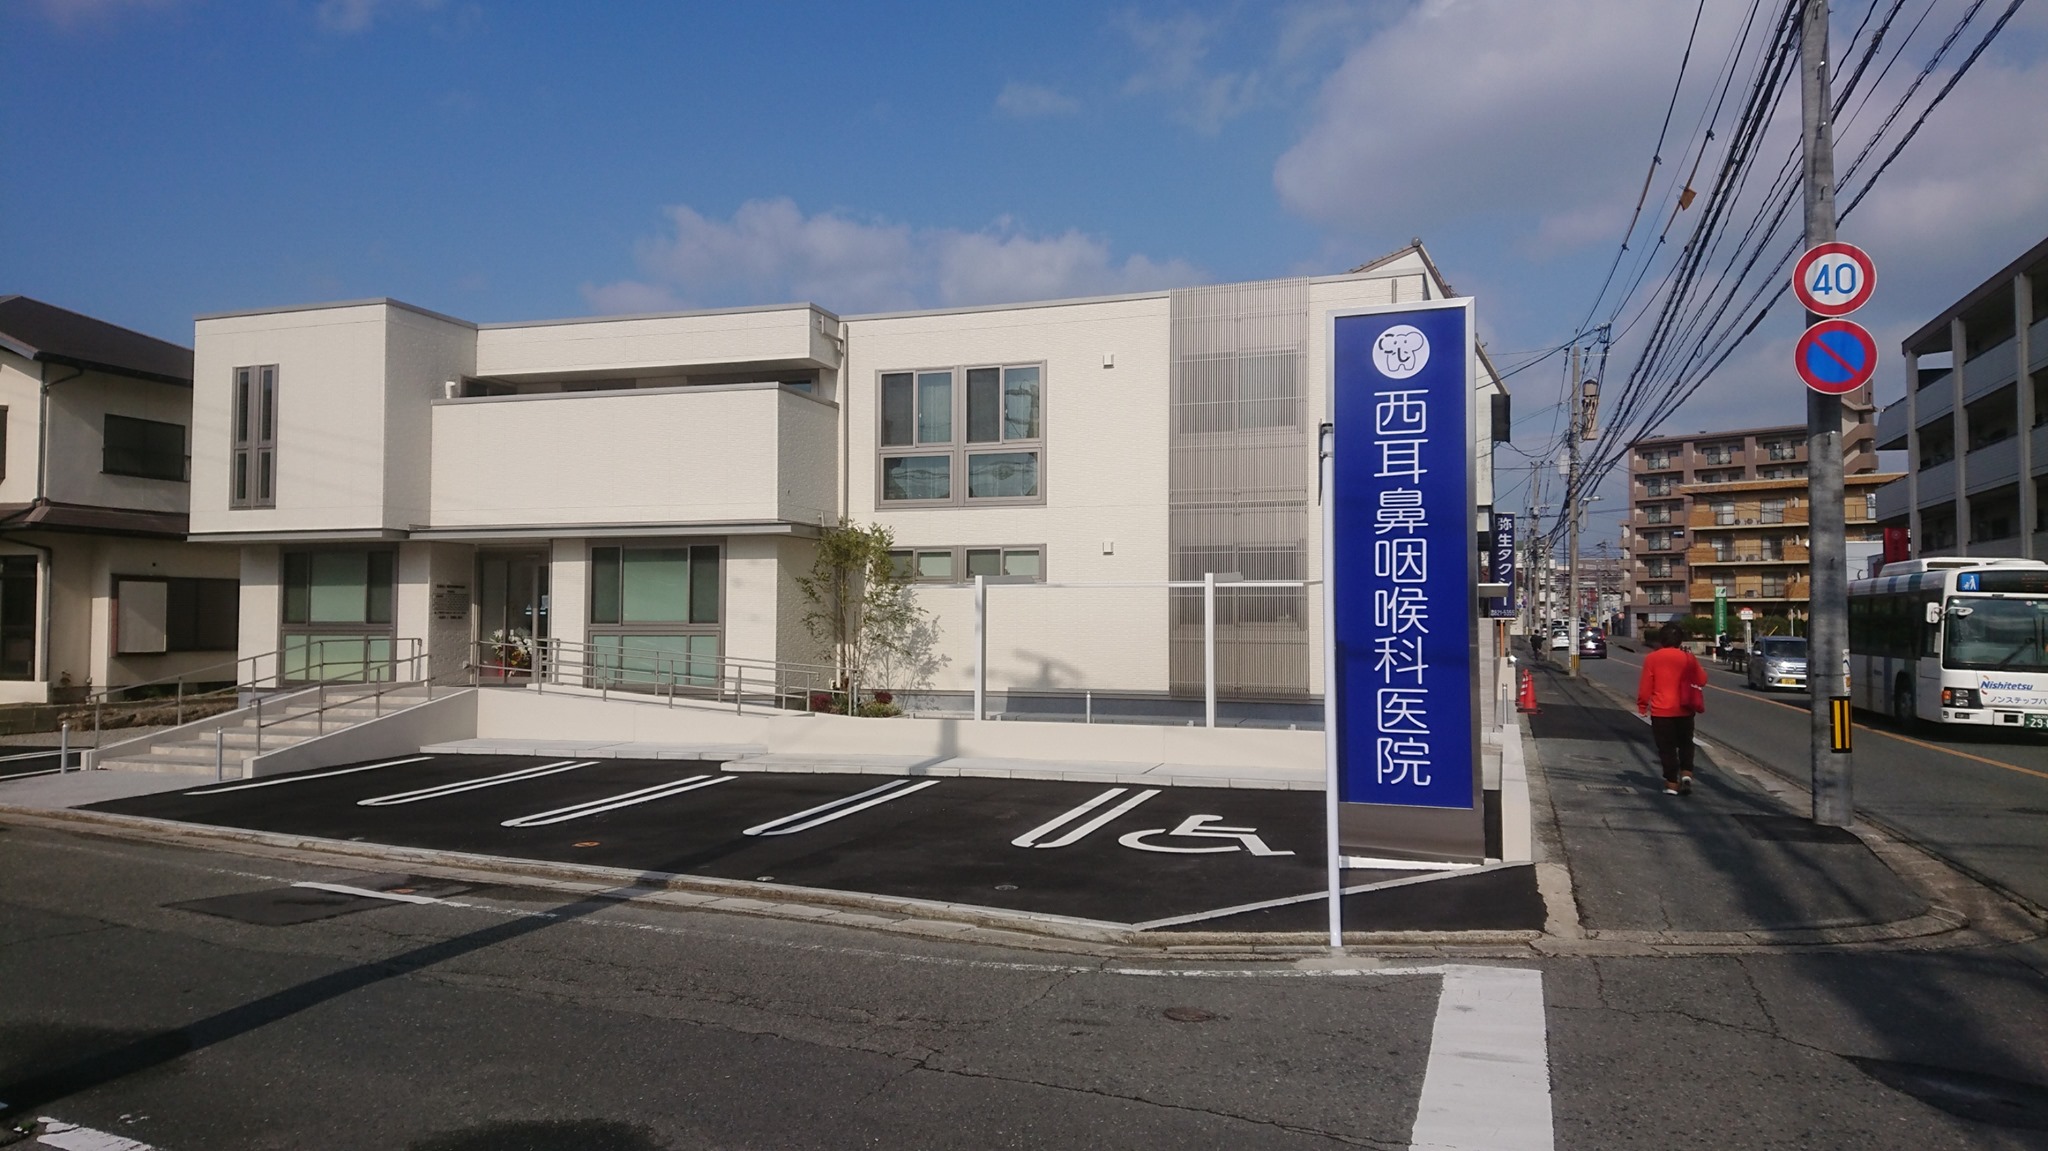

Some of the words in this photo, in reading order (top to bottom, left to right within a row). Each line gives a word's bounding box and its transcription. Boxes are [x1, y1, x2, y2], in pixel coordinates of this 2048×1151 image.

[1812, 262, 1857, 295] 40
[1373, 388, 1432, 787] 西耳鼻咽喉科医院
[1980, 680, 2034, 691] Nishitetsu
